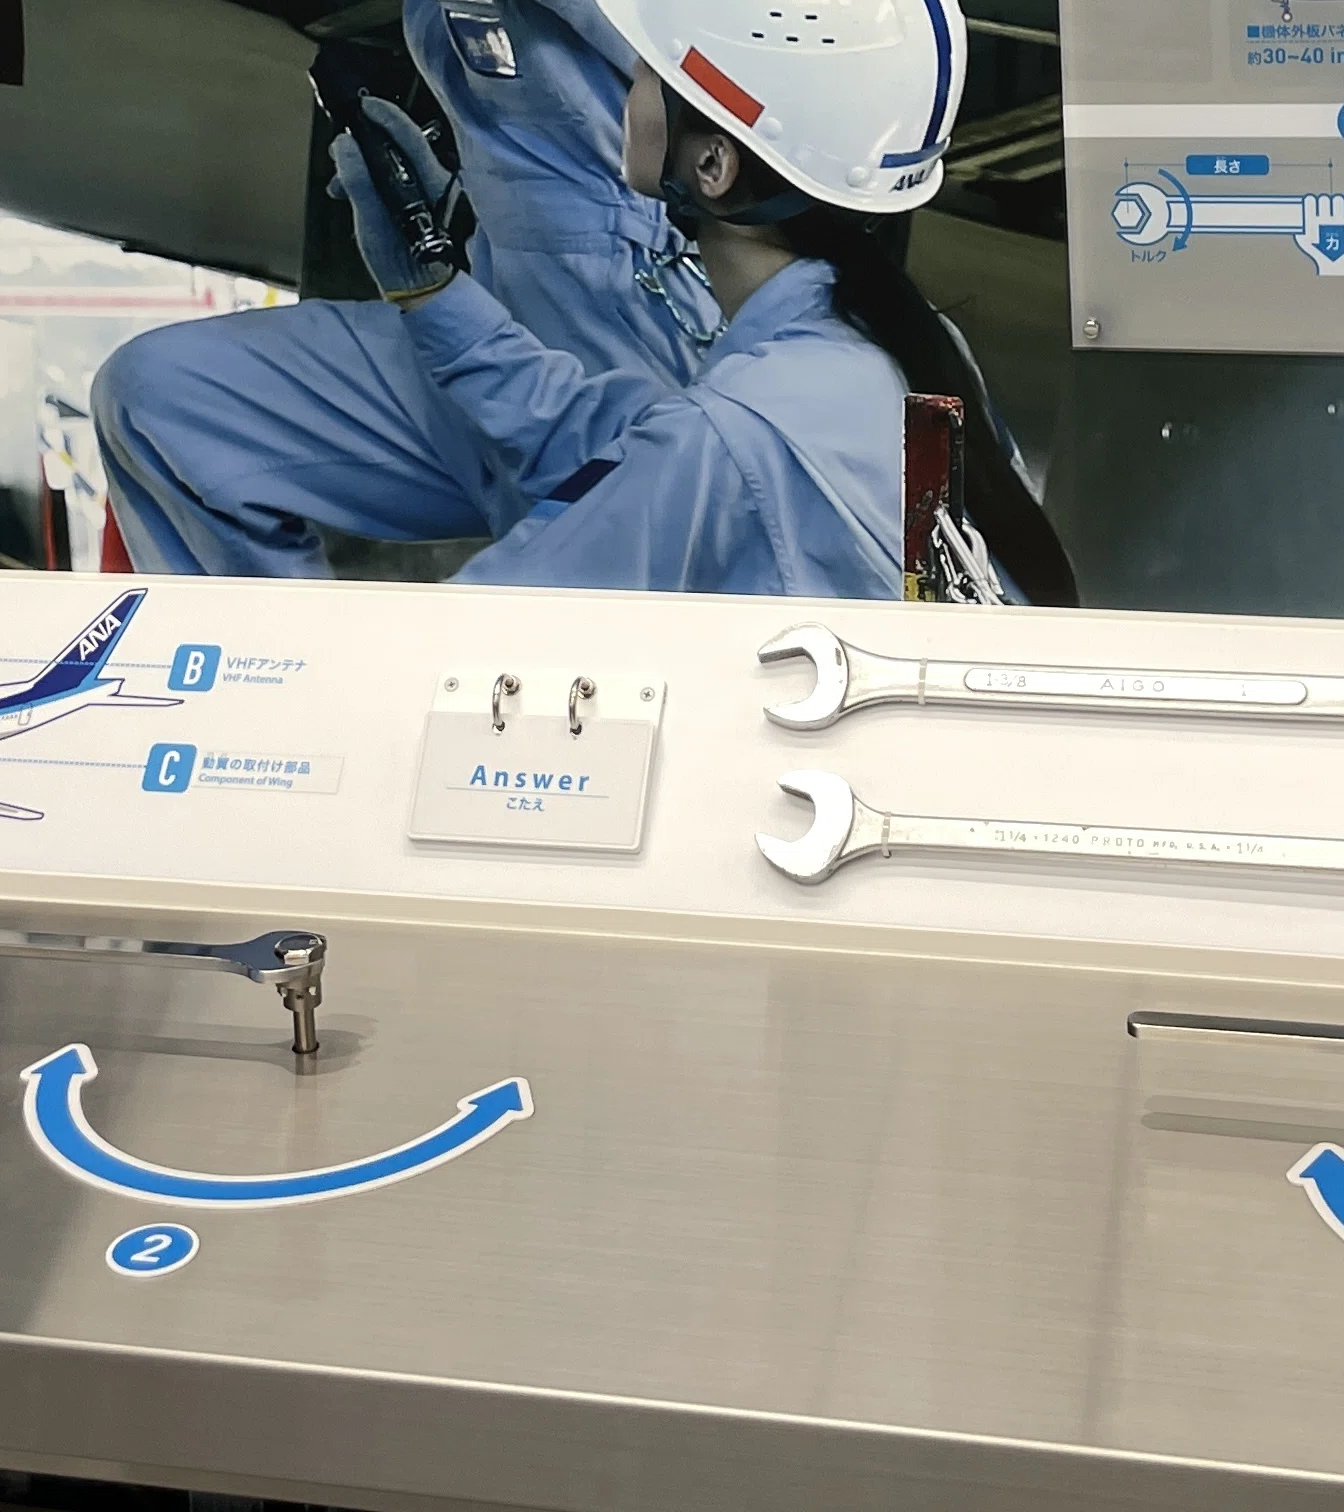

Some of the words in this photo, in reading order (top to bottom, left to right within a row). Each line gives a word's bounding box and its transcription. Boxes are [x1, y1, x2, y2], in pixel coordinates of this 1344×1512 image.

[1213, 159, 1241, 175] 長さ
[1325, 236, 1340, 251] 力
[1131, 250, 1166, 263] トルク
[78, 614, 122, 660] ANA
[183, 651, 205, 685] B
[226, 657, 307, 672] VHFアンテナ
[223, 673, 241, 683] VHF
[242, 673, 284, 684] Antenna
[1100, 679, 1165, 692] AIGO
[158, 751, 180, 785] C
[198, 773, 255, 786] Component
[256, 776, 268, 785] of
[269, 777, 293, 788] Wing
[469, 765, 590, 791] Answer
[506, 796, 545, 812] こたえ
[1043, 833, 1080, 845] 1240
[1091, 835, 1145, 848] PROTO
[130, 1234, 174, 1263] 2
